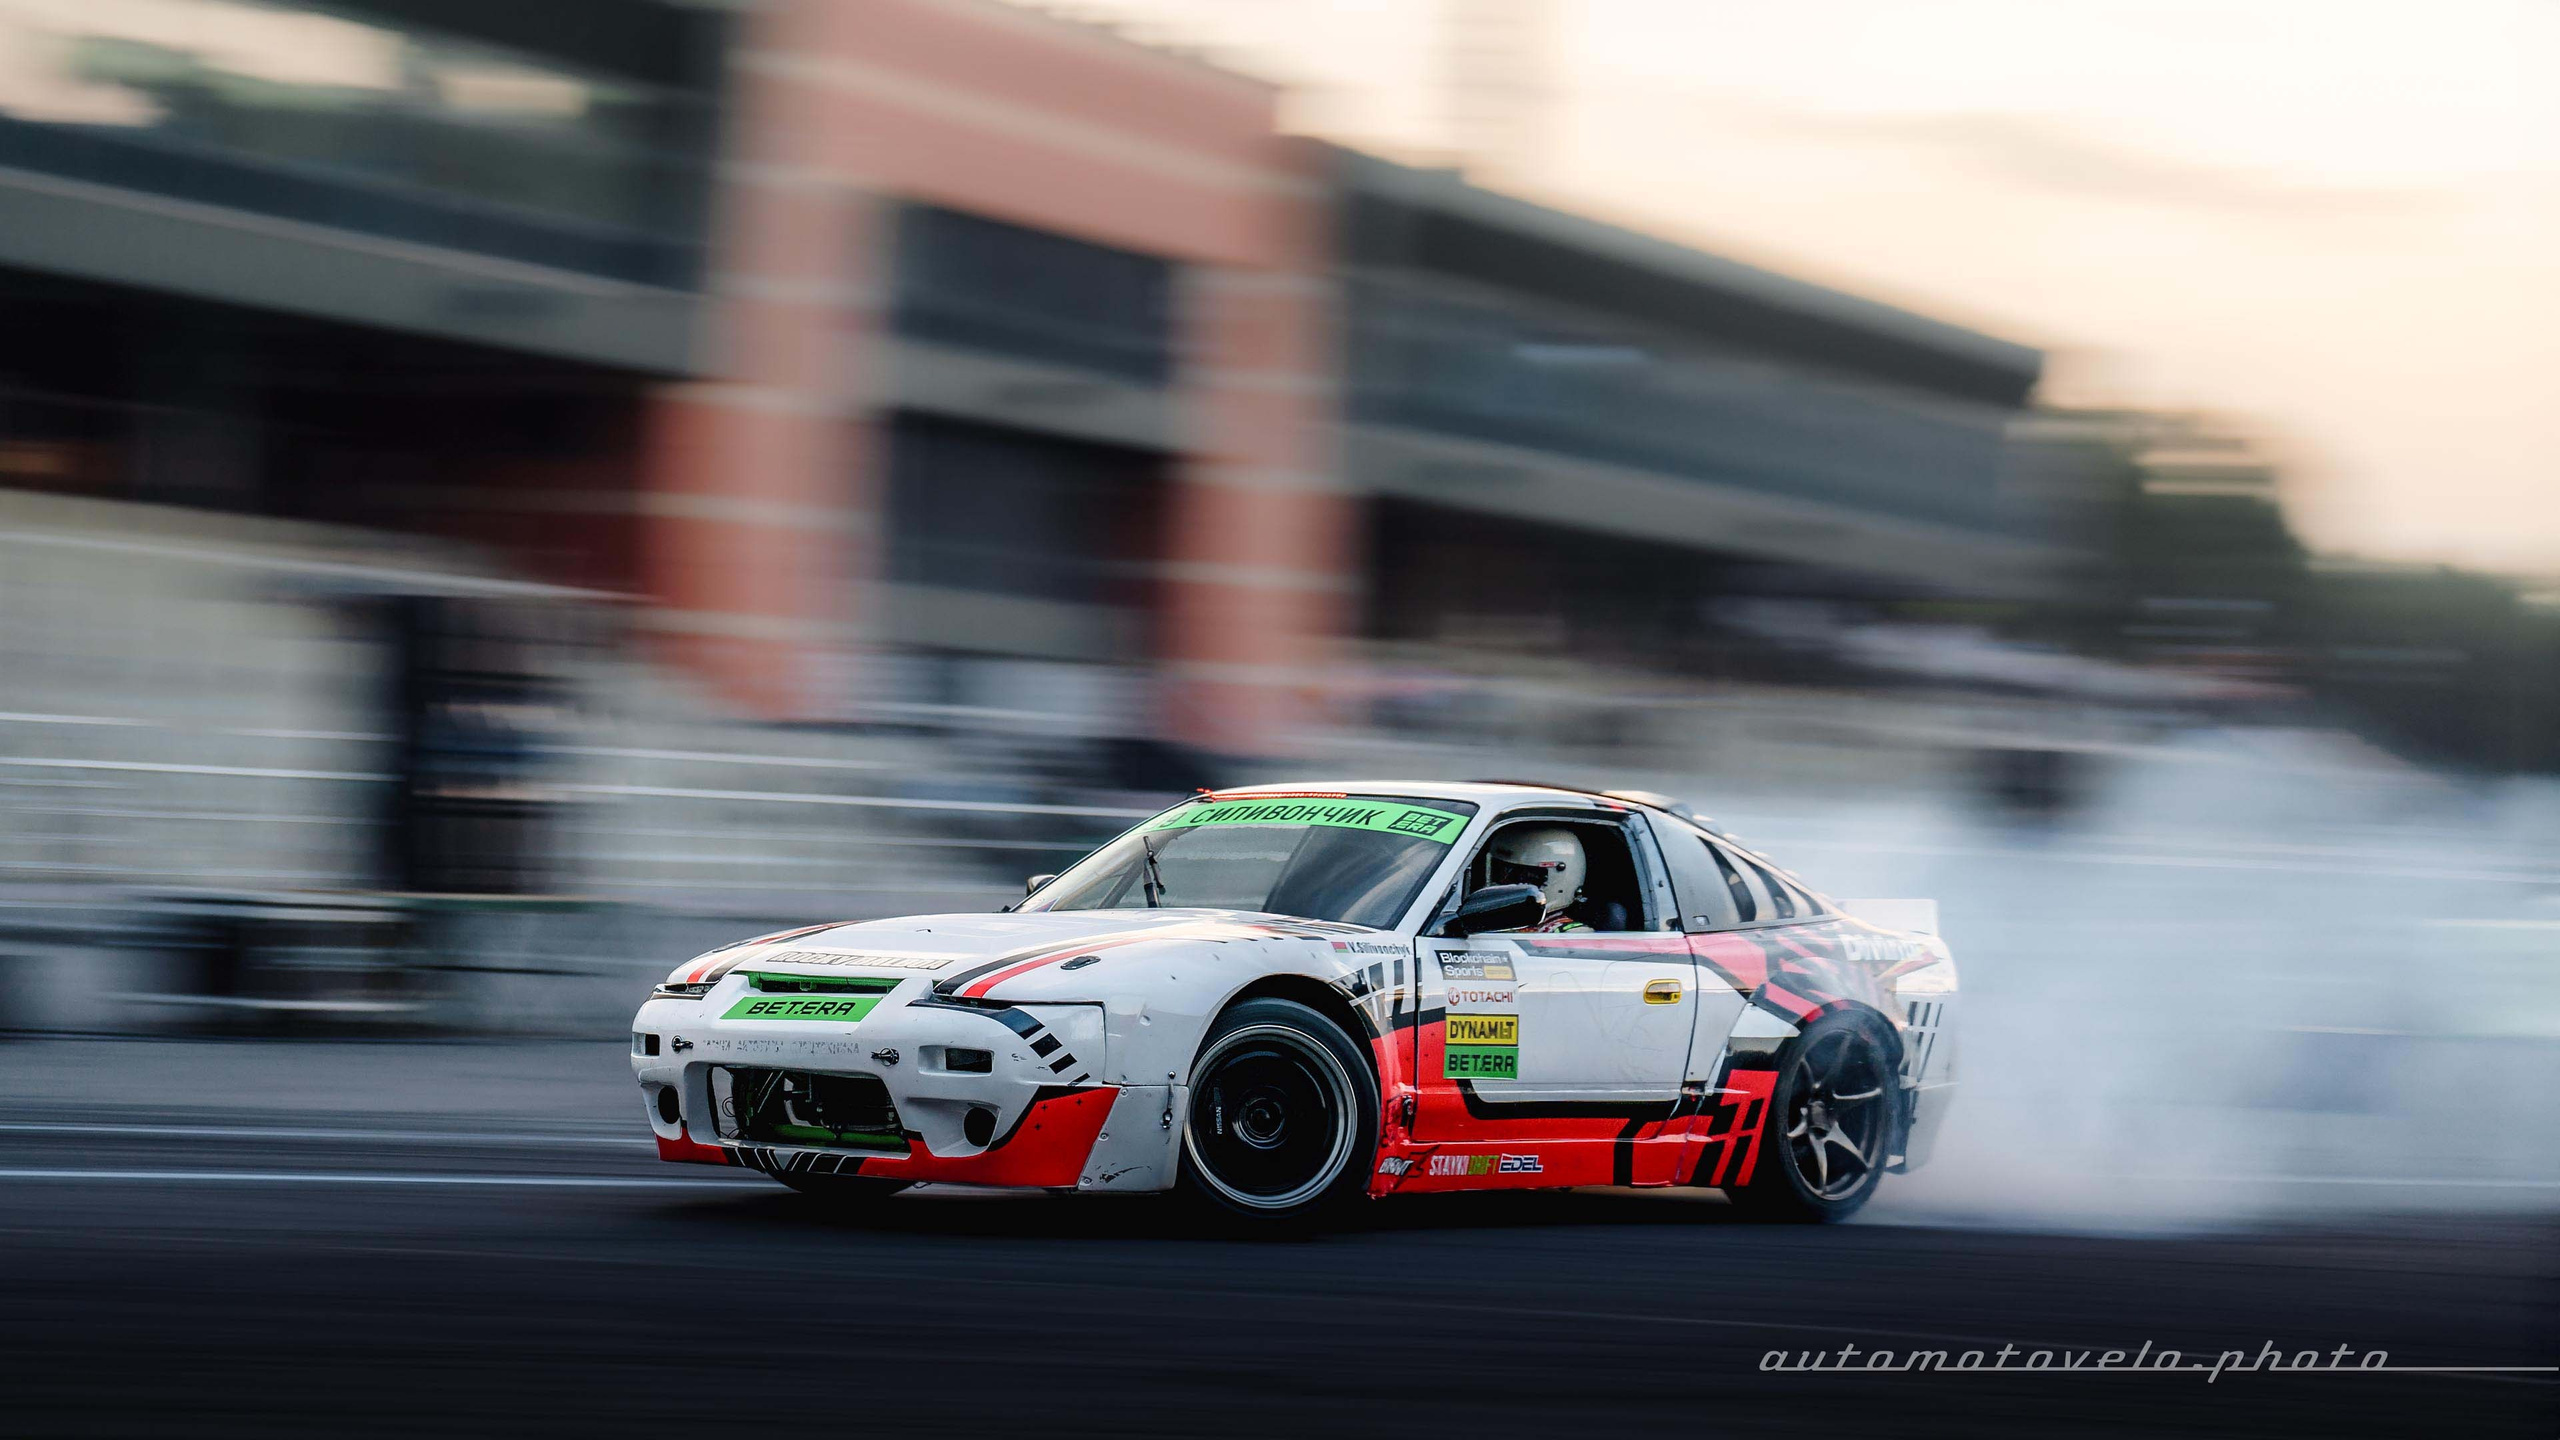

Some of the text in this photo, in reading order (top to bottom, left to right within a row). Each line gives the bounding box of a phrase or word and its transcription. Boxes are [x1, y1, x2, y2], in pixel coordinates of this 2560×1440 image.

[1190, 804, 1384, 825] СИЛИВОНЧИК
[1402, 812, 1449, 825] BET
[1390, 820, 1438, 834] ERA
[1439, 951, 1503, 964] Blockchain
[1444, 964, 1484, 978] Sports
[1461, 990, 1514, 1004] TOTACHI
[745, 1001, 856, 1016] BET.ERA
[1500, 1154, 1543, 1173] EDEL
